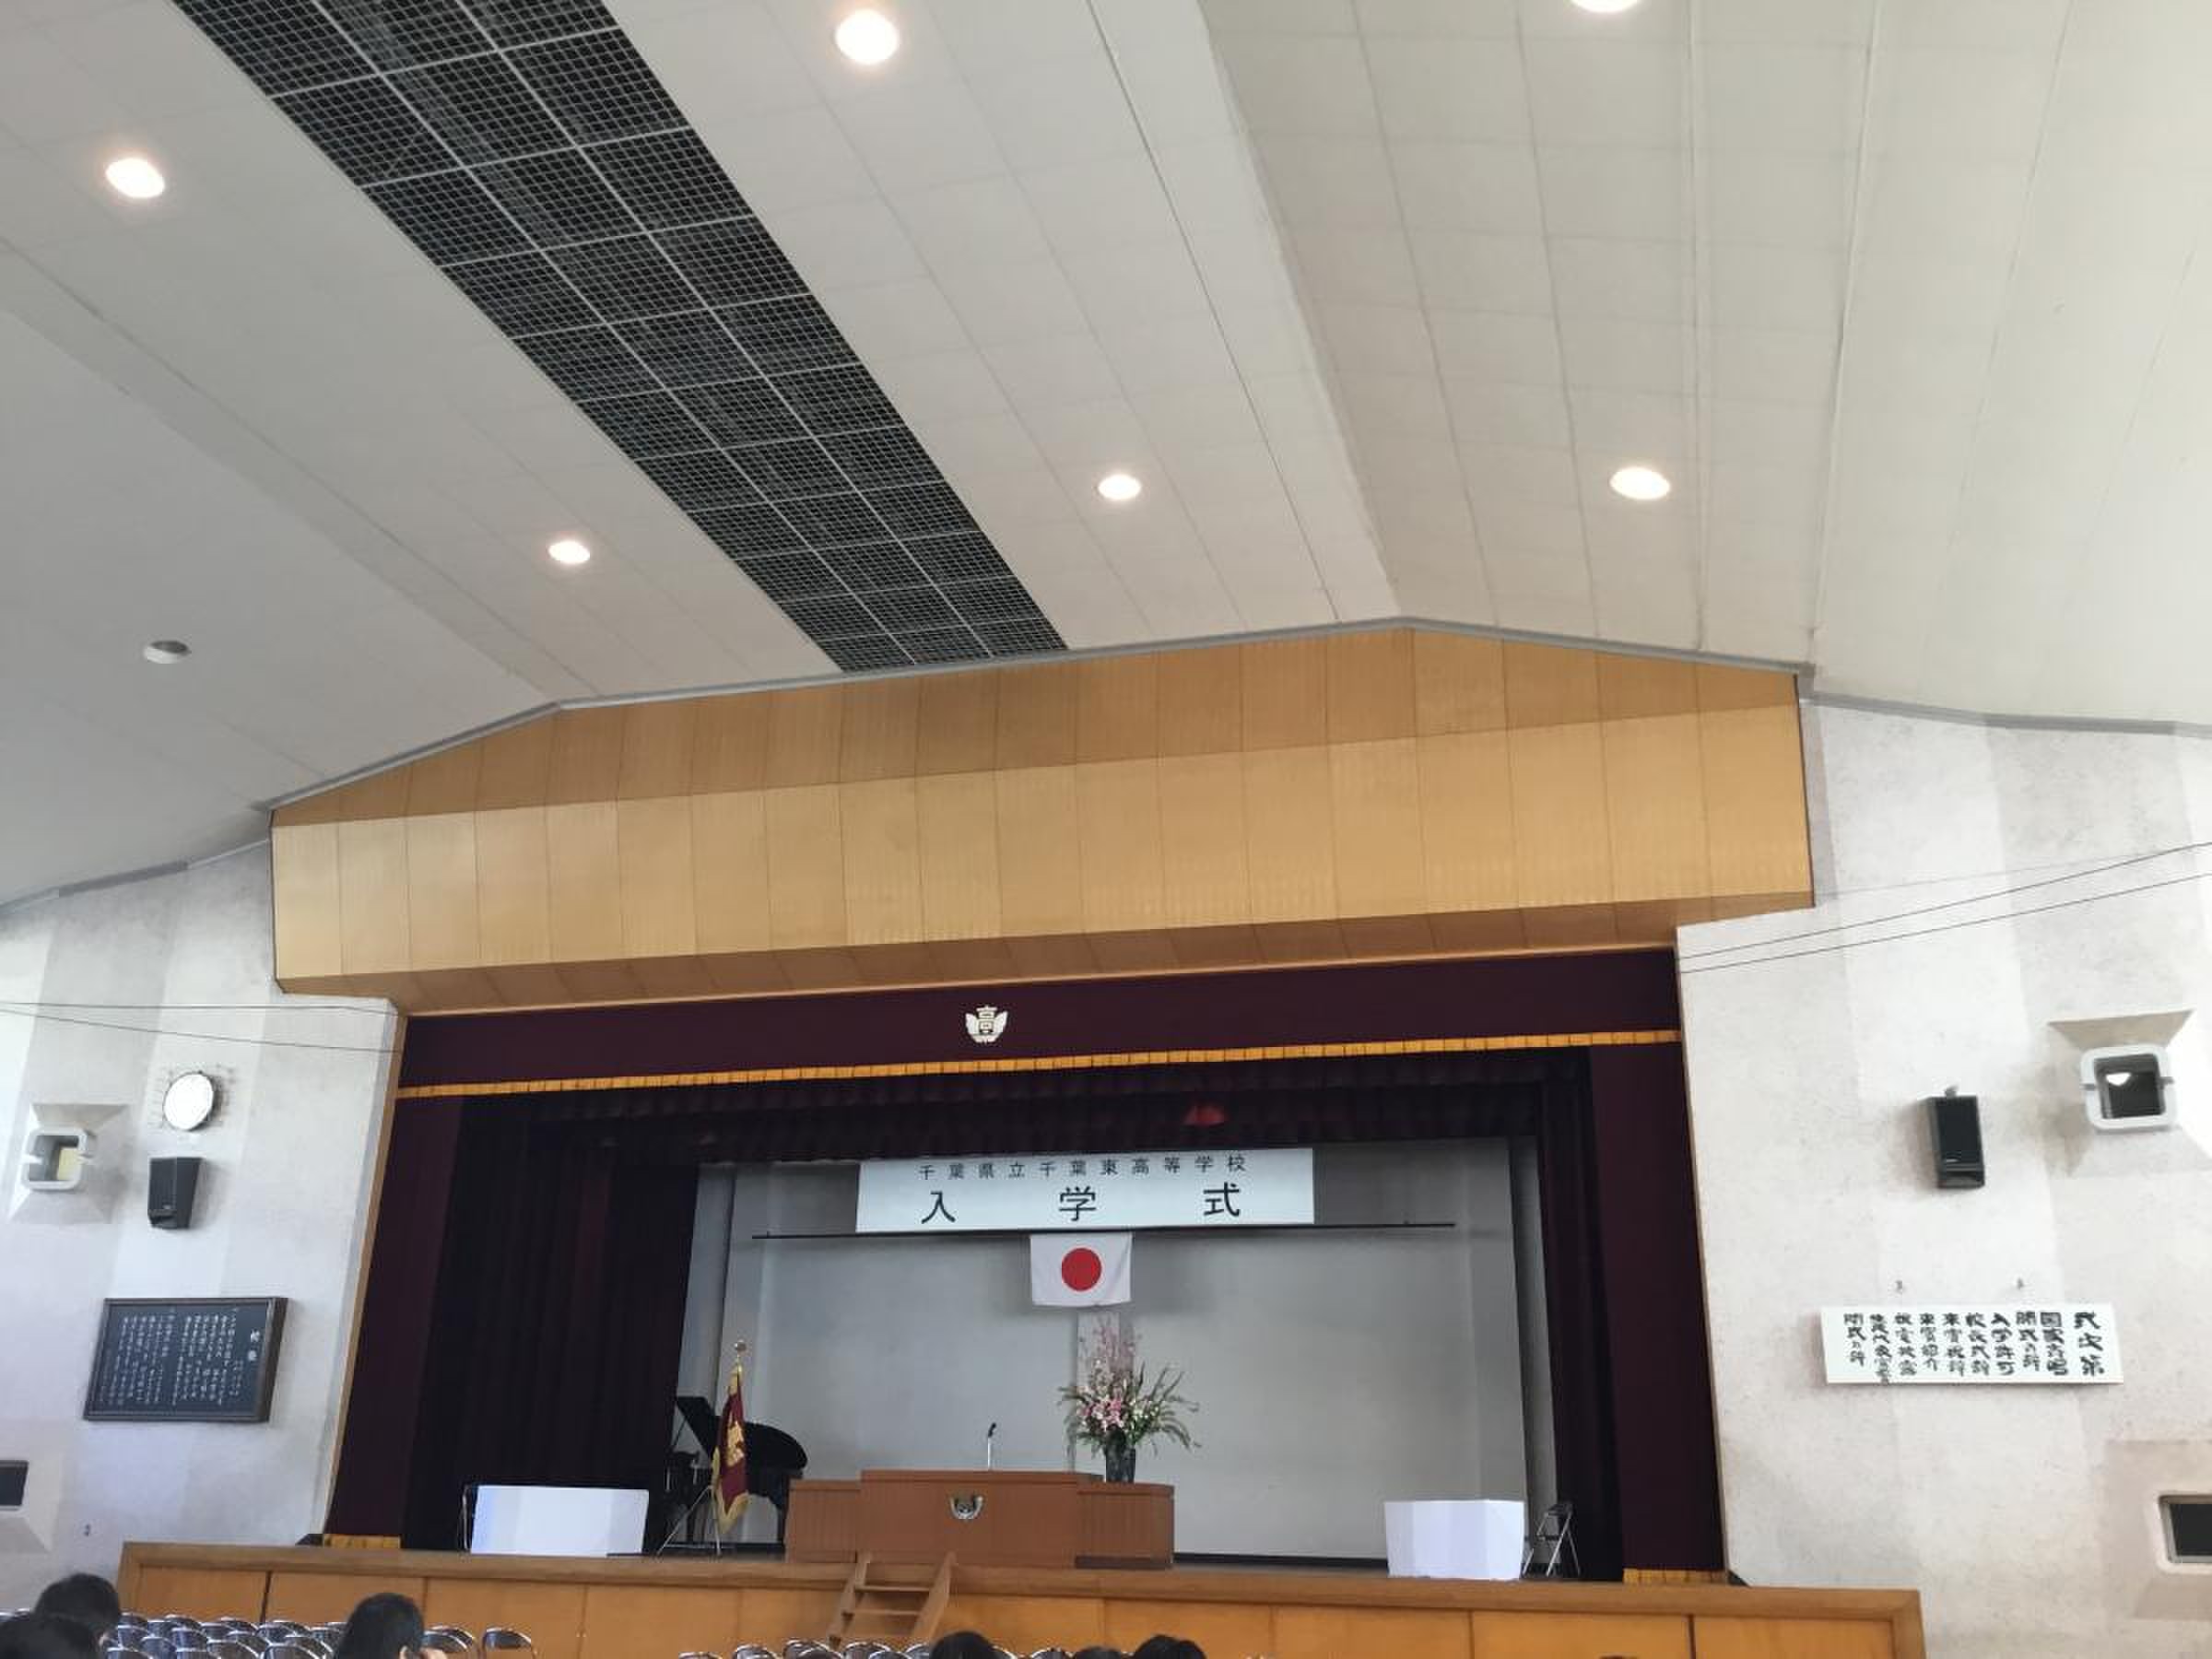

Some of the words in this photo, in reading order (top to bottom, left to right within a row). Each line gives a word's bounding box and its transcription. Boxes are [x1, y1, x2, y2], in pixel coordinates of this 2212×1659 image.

[919, 1155, 1248, 1181] 千葉県立千葉東高等学校
[922, 1182, 1241, 1225] 入学式
[1991, 1312, 2016, 1376] 入学許可
